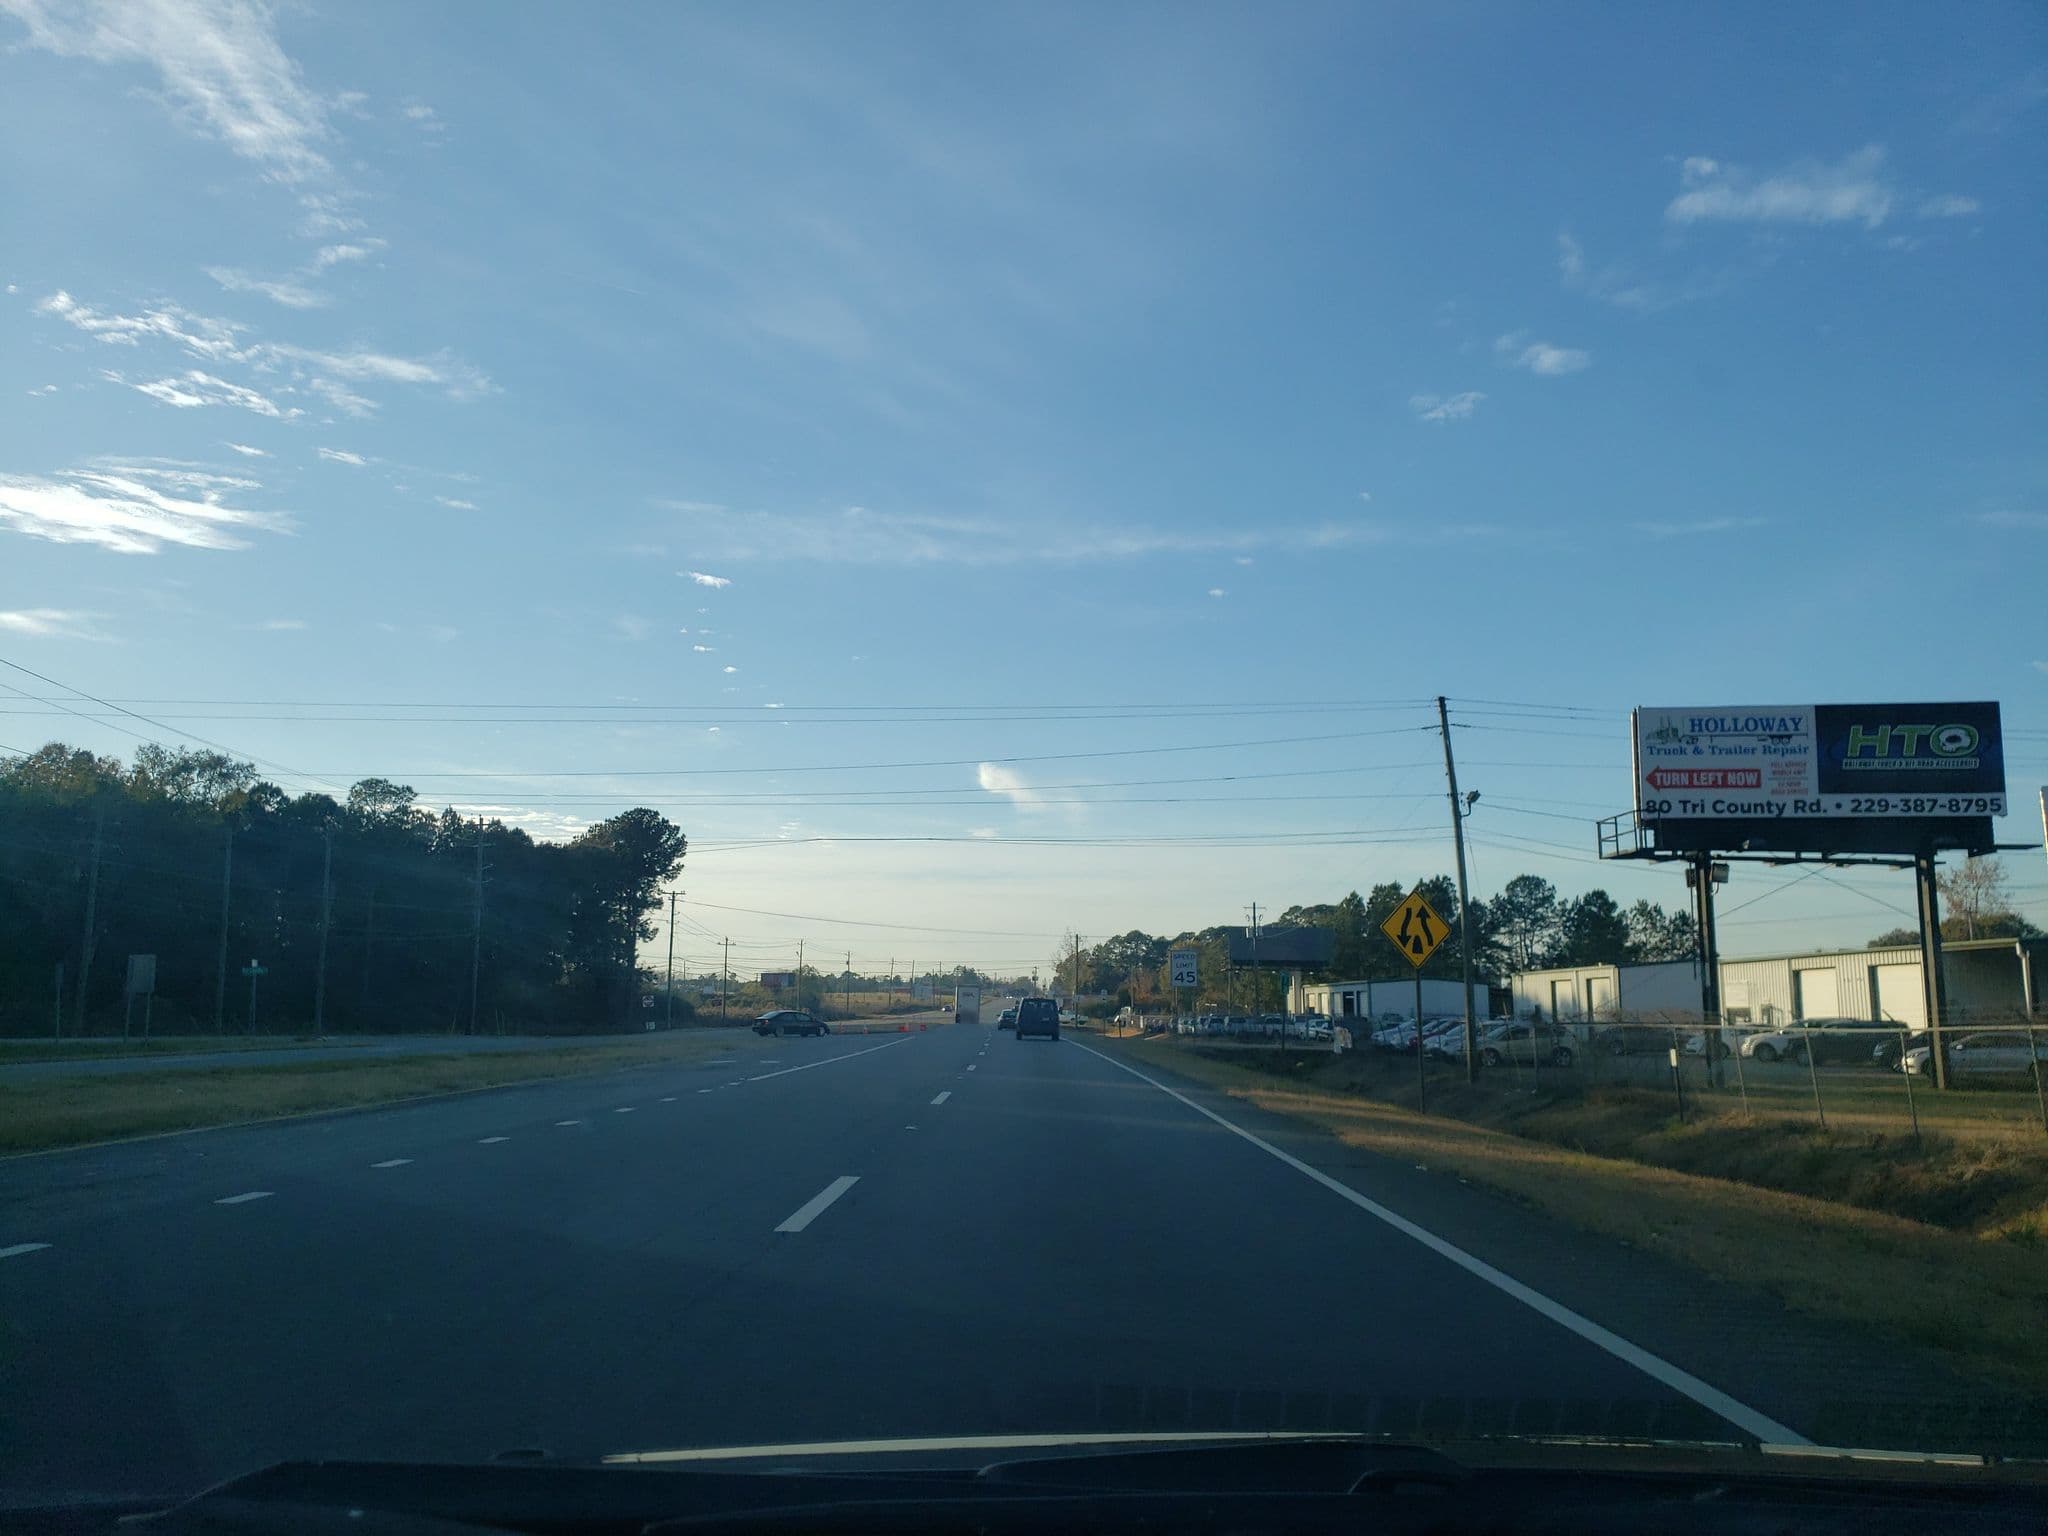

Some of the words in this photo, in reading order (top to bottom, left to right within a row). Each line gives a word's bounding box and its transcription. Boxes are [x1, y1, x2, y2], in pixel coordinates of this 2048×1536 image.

[1689, 717, 1803, 733] HOLLOWAY
[1647, 745, 1688, 756] Truck
[1692, 745, 1704, 756] &
[1709, 745, 1757, 756] Trailer
[1762, 744, 1809, 757] Repair
[1655, 772, 1688, 786] TURN
[1693, 772, 1724, 786] LEFT
[1728, 772, 1759, 786] NOW
[1678, 799, 1705, 814] Tri
[1712, 799, 1787, 818] County
[1794, 799, 1827, 814] Rd.
[1850, 797, 2002, 814] 229-387-8795
[1174, 971, 1196, 983] 45
